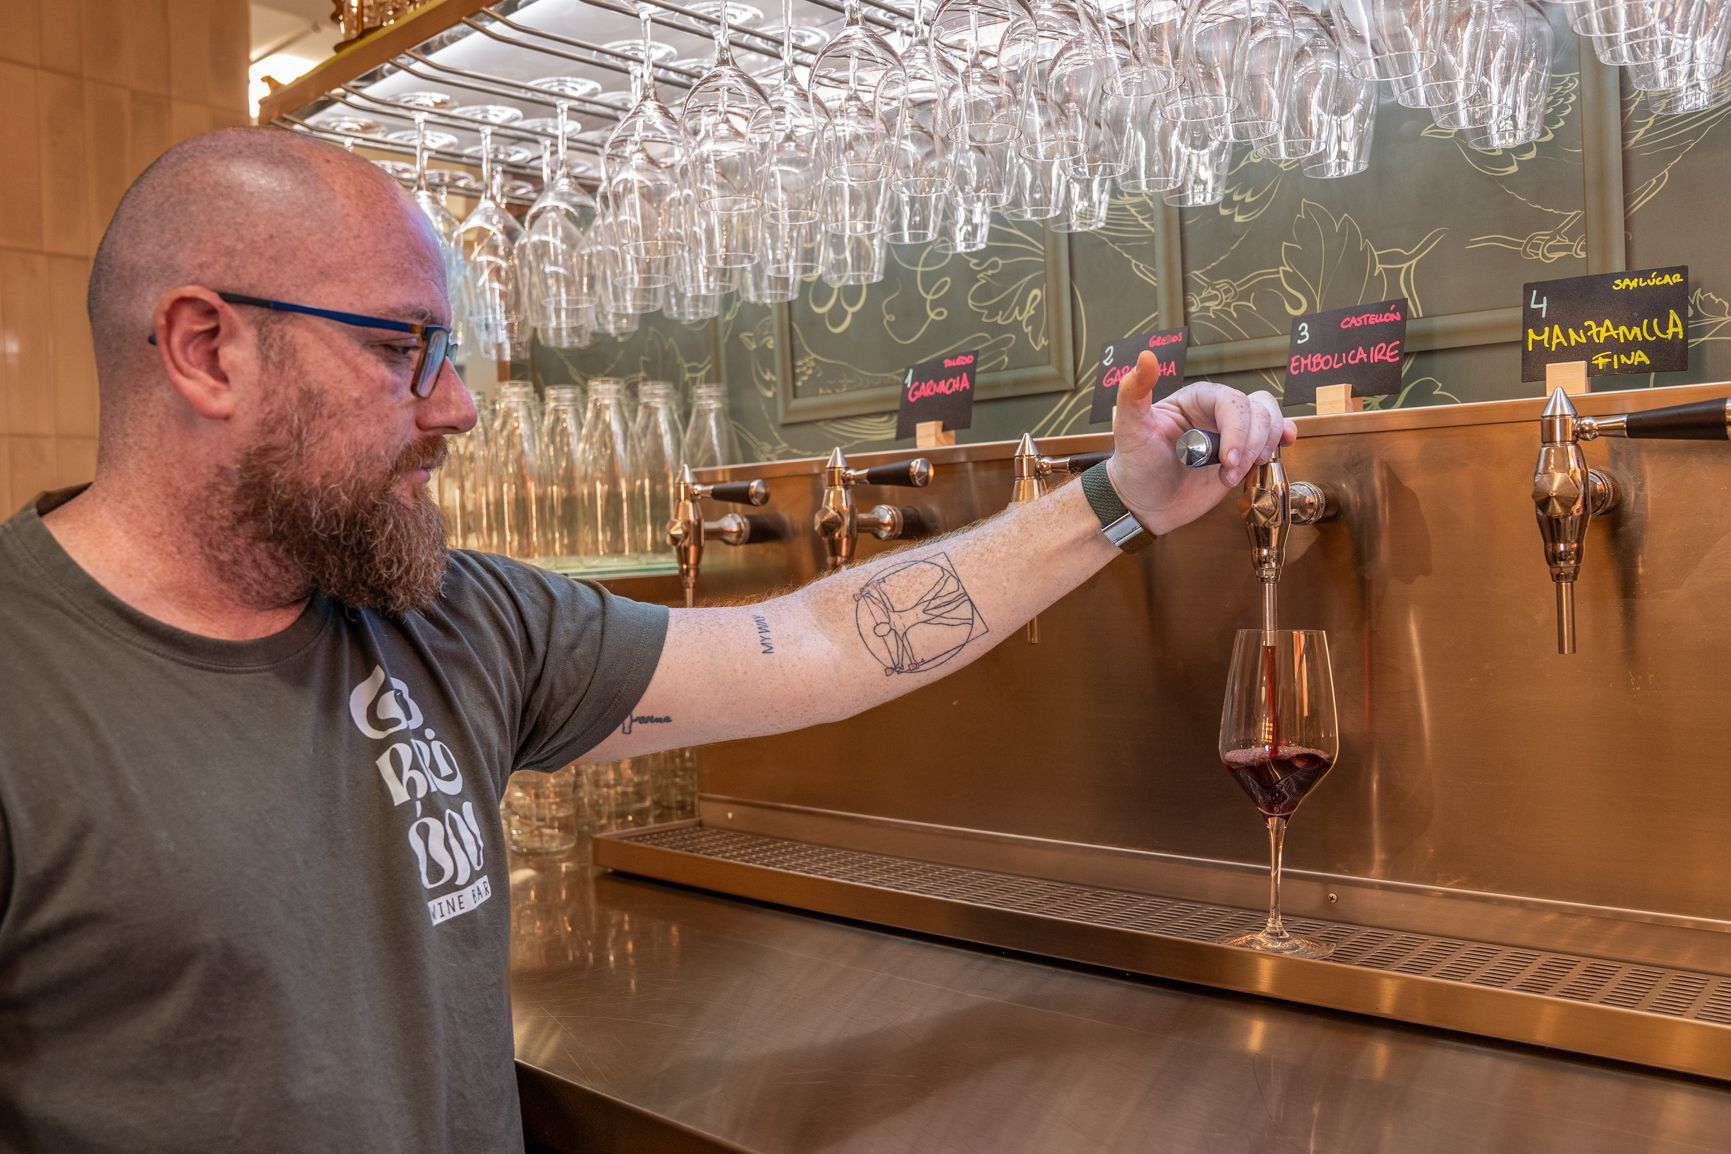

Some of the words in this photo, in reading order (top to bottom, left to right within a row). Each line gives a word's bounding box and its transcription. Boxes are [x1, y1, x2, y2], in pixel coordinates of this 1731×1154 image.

[1530, 290, 1547, 318] 4
[1340, 304, 1401, 329] CASTELLÓN
[1297, 322, 1310, 344] 3
[1103, 345, 1114, 366] 2
[1289, 340, 1400, 375] EMBOLICAIRE
[1592, 350, 1650, 369] FINA
[904, 368, 914, 389] 1
[1102, 360, 1177, 388] GARHA
[908, 372, 970, 403] GARNACHA
[760, 635, 775, 654] MY
